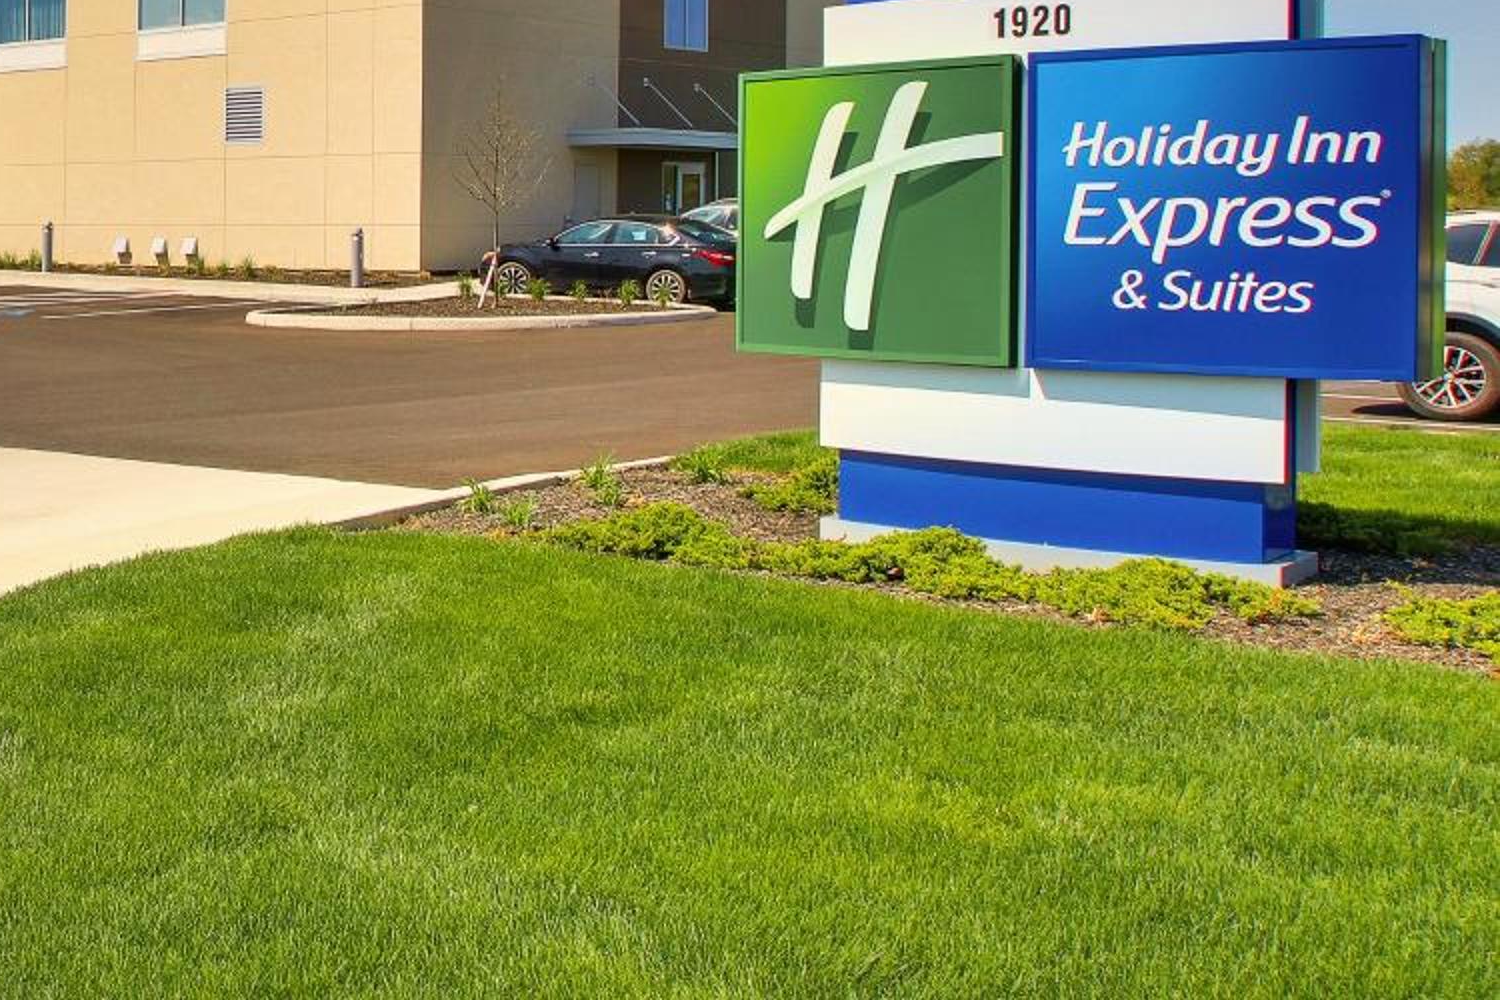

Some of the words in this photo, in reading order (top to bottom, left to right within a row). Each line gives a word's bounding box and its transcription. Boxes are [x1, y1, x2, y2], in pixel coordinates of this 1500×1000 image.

[992, 3, 1073, 38] 1920
[1062, 119, 1279, 175] Holiday
[1287, 115, 1381, 165] Inn
[1112, 269, 1147, 310] &
[1158, 269, 1314, 313] Suites
